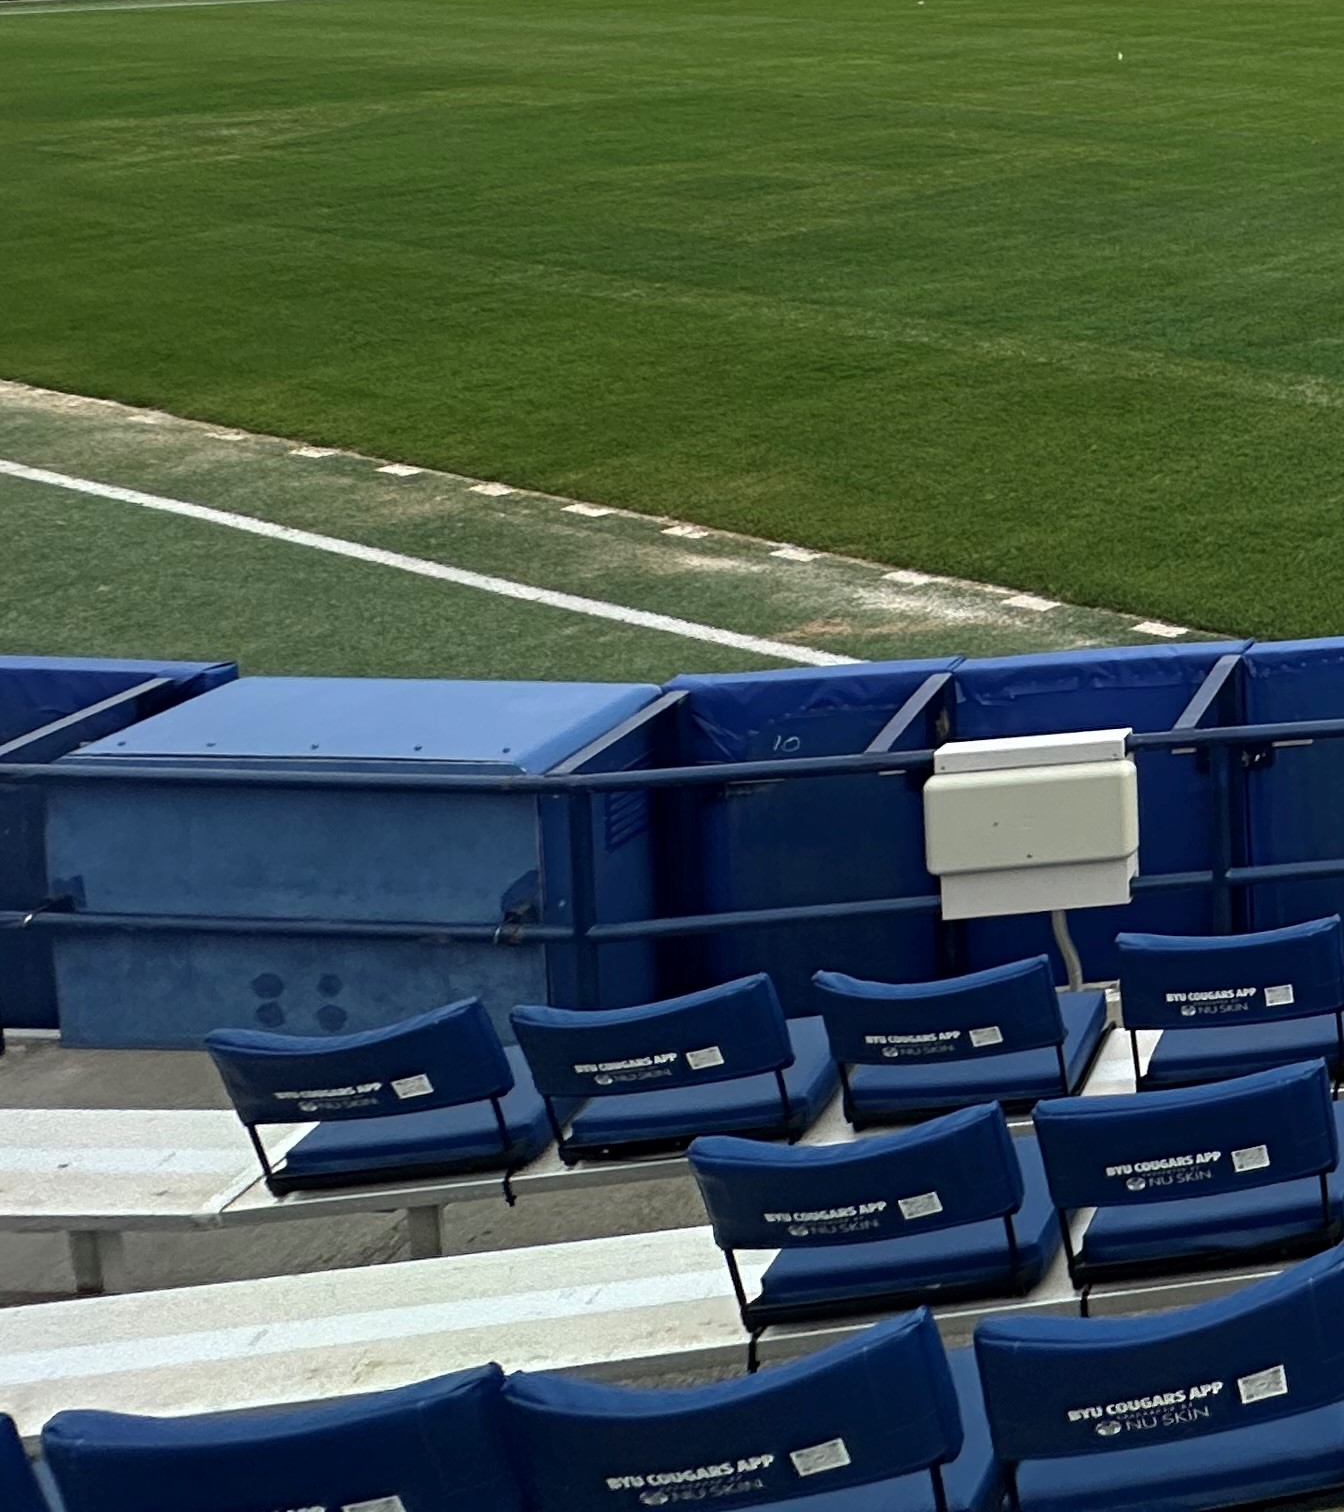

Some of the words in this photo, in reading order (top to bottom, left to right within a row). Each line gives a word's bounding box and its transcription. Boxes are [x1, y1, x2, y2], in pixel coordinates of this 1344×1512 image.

[1188, 989, 1235, 1001] COUGARS
[1236, 987, 1257, 997] APP
[1105, 1164, 1133, 1176] BYU
[1134, 1155, 1194, 1172] COUGARS
[1195, 1151, 1221, 1164] APP
[1148, 1175, 1174, 1187] NU
[1176, 1169, 1212, 1184] SKIN
[1067, 1405, 1103, 1422] BYU
[1105, 1390, 1186, 1415] COUGARS
[1189, 1381, 1224, 1400] APP
[1126, 1416, 1158, 1431] NU
[1161, 1406, 1210, 1426] SKIN
[736, 1454, 774, 1473] APP
